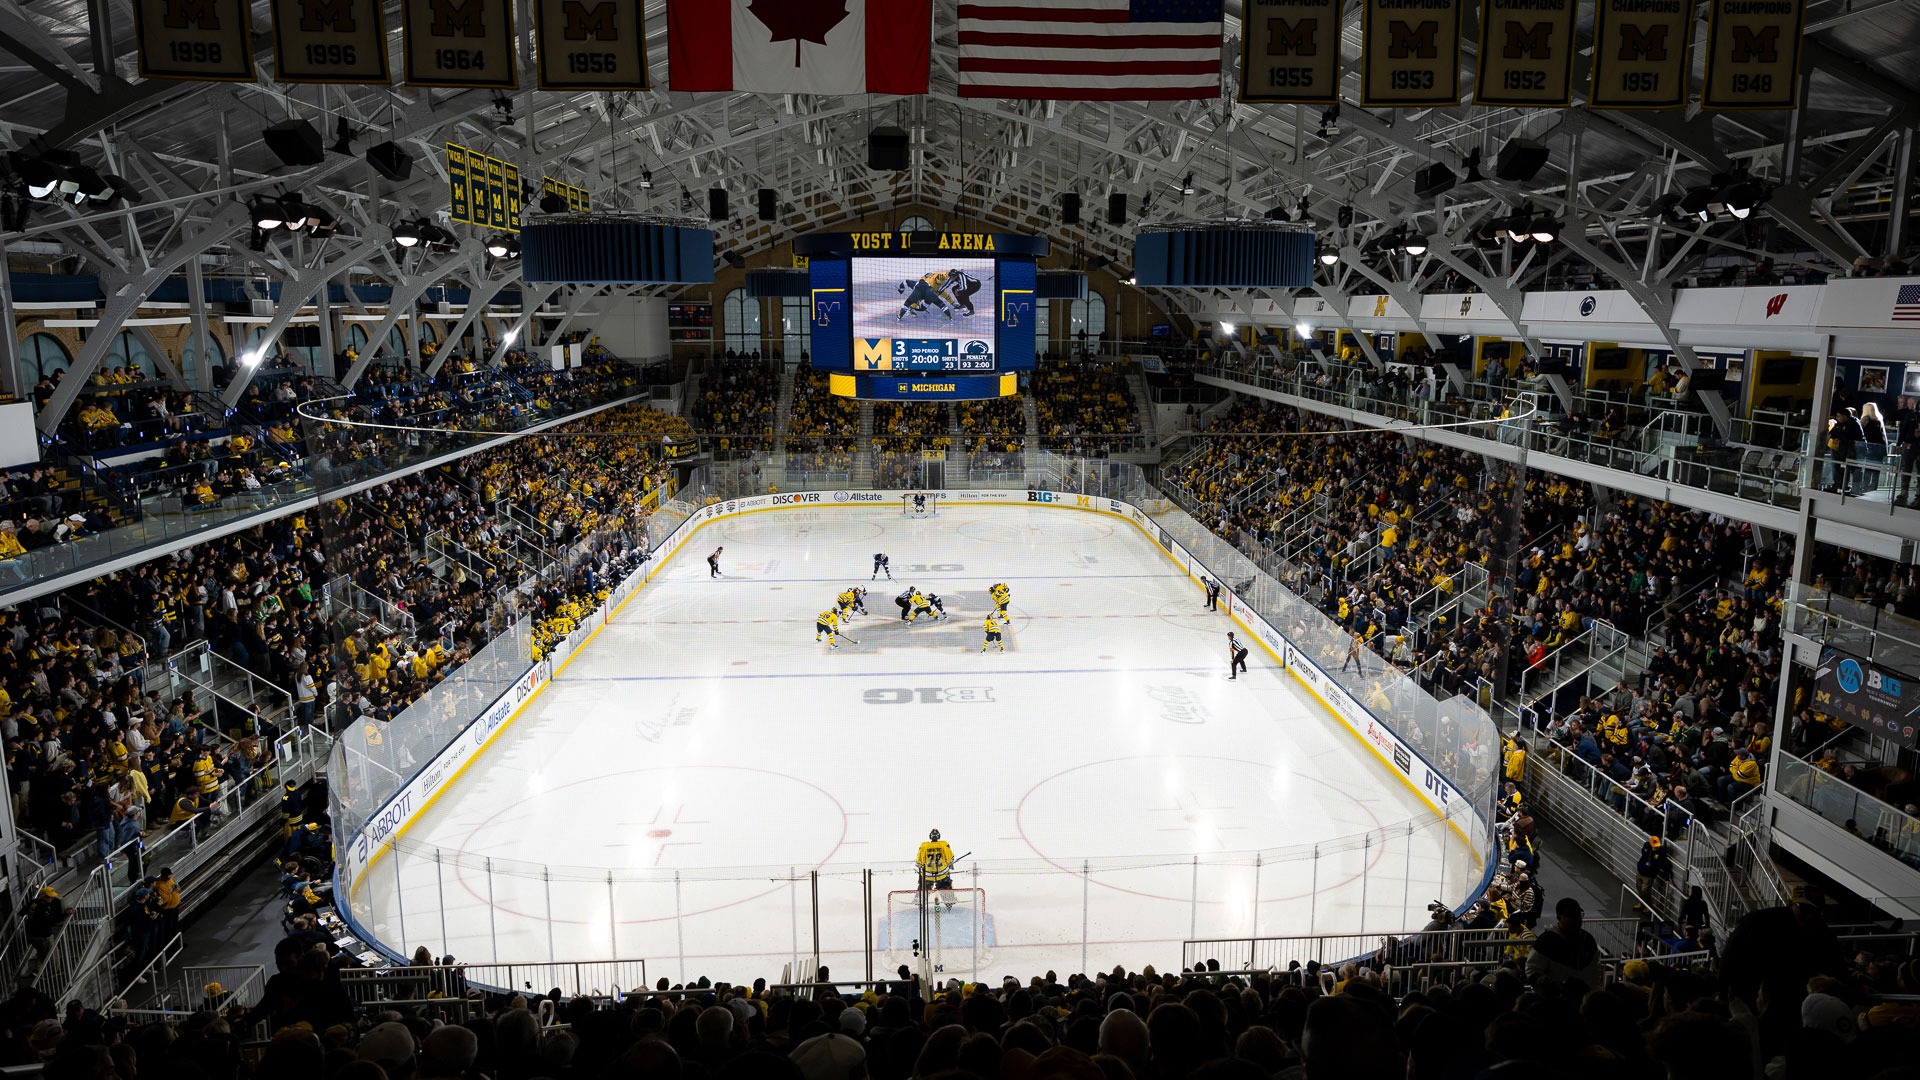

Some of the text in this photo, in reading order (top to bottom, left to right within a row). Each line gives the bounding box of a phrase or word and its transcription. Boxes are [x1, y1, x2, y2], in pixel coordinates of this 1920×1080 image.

[1612, 0, 1680, 13] CHAMPIONS
[1723, 2, 1792, 14] CHAMPIONS
[563, 1, 618, 40] M
[1267, 18, 1318, 56] M
[1389, 20, 1438, 58] M
[1503, 21, 1553, 60] M
[1618, 24, 1668, 60] M
[1732, 26, 1780, 62] M
[169, 42, 222, 64] 1998
[305, 44, 356, 65] 1996
[436, 49, 484, 70] 1964
[568, 53, 617, 74] 1956
[1270, 67, 1313, 87] 1955
[1391, 70, 1434, 90] 1953
[1503, 70, 1546, 90] 1952
[1622, 72, 1660, 92] 1951
[1732, 74, 1772, 92] 1948
[454, 182, 464, 201] M
[474, 188, 484, 206] M
[493, 194, 502, 210] M
[510, 197, 518, 214] M
[851, 233, 892, 249] YOST
[938, 233, 995, 250] ARENA
[1374, 296, 1390, 316] M
[895, 341, 905, 355] 3
[945, 341, 952, 355] 1
[912, 355, 939, 363] 20:00
[772, 493, 820, 505] DISCOVER
[849, 492, 882, 501] Allstate
[1076, 495, 1090, 507] M
[1294, 656, 1317, 683] PINKERTON
[516, 661, 547, 703] DISCOVER
[1815, 689, 1831, 704] M
[1868, 695, 1897, 708] TOURNAMENT
[487, 701, 510, 734] Allstate
[423, 770, 441, 792] Hilton
[1425, 770, 1448, 805] DTE
[371, 791, 412, 848] ABBOTT
